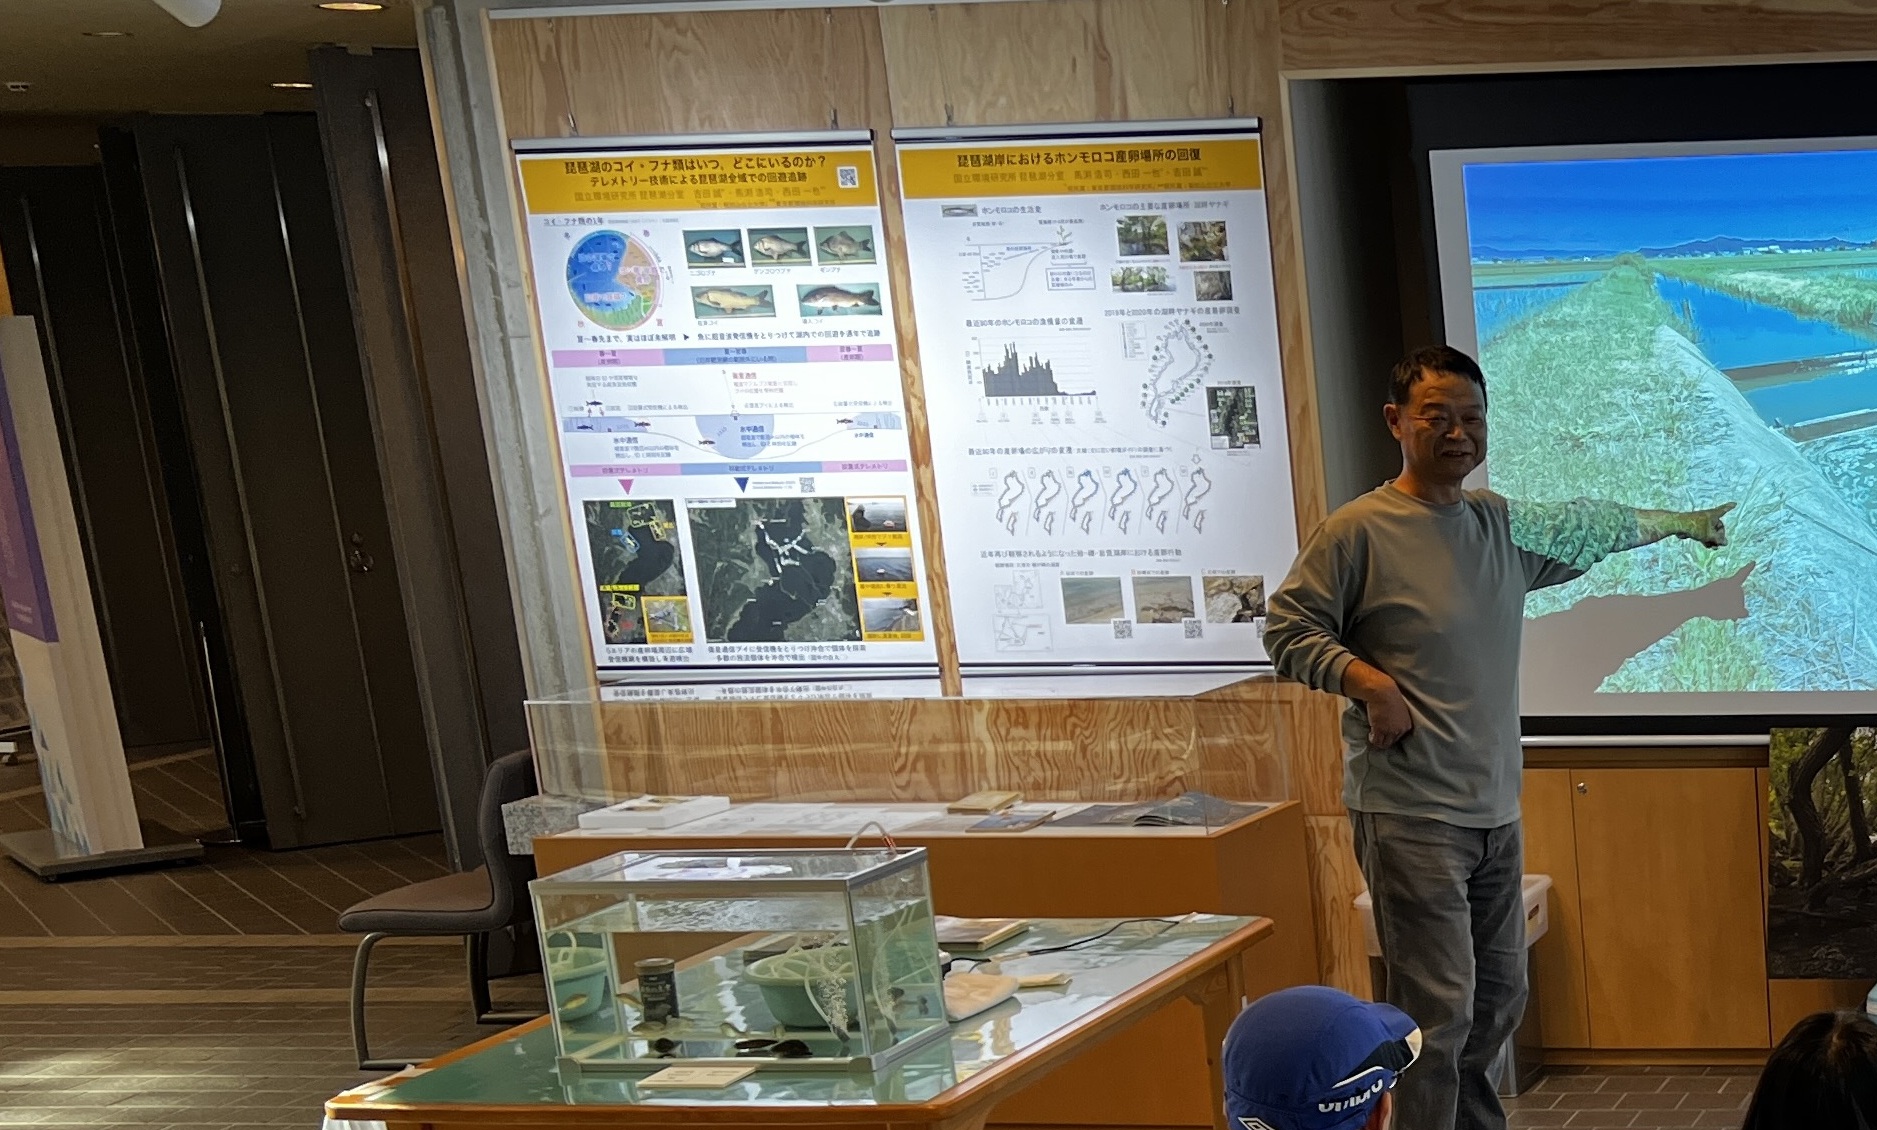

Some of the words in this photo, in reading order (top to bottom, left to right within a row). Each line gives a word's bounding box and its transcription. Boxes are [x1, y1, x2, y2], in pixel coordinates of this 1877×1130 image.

[957, 148, 1201, 168] 琵琶湖岸におけるホンモロコ産卵場所の回復
